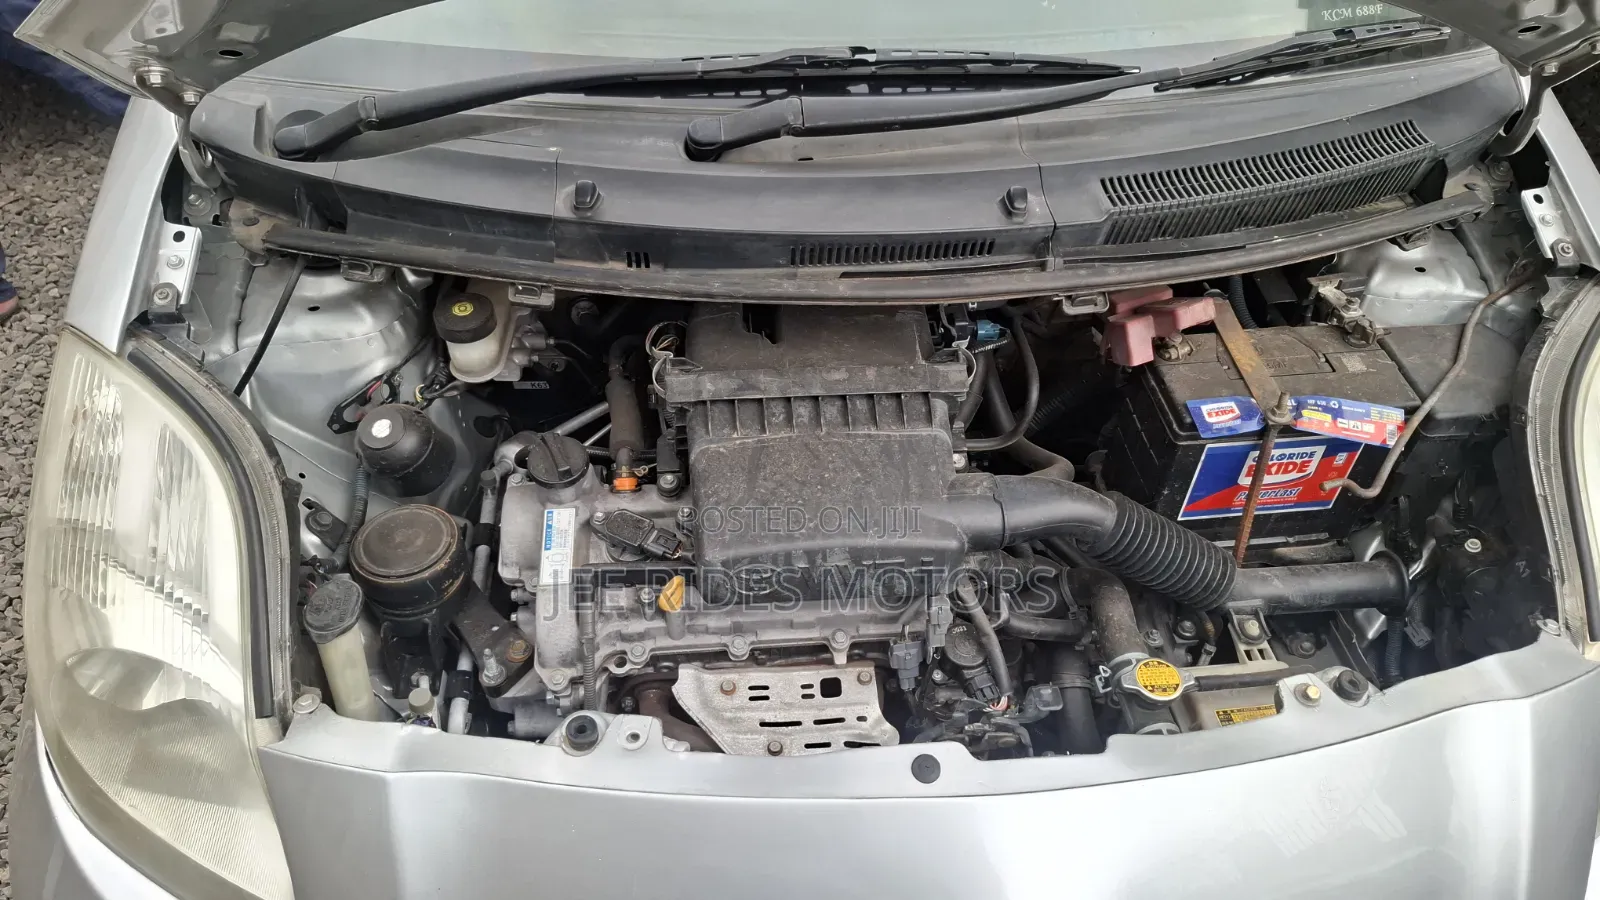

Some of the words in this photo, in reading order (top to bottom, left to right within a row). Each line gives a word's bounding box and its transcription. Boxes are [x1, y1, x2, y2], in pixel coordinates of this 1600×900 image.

[1321, 8, 1353, 21] KCM
[1356, 4, 1383, 16] 688F
[1207, 408, 1237, 419] EXIDE
[1252, 451, 1317, 462] CLORIDE
